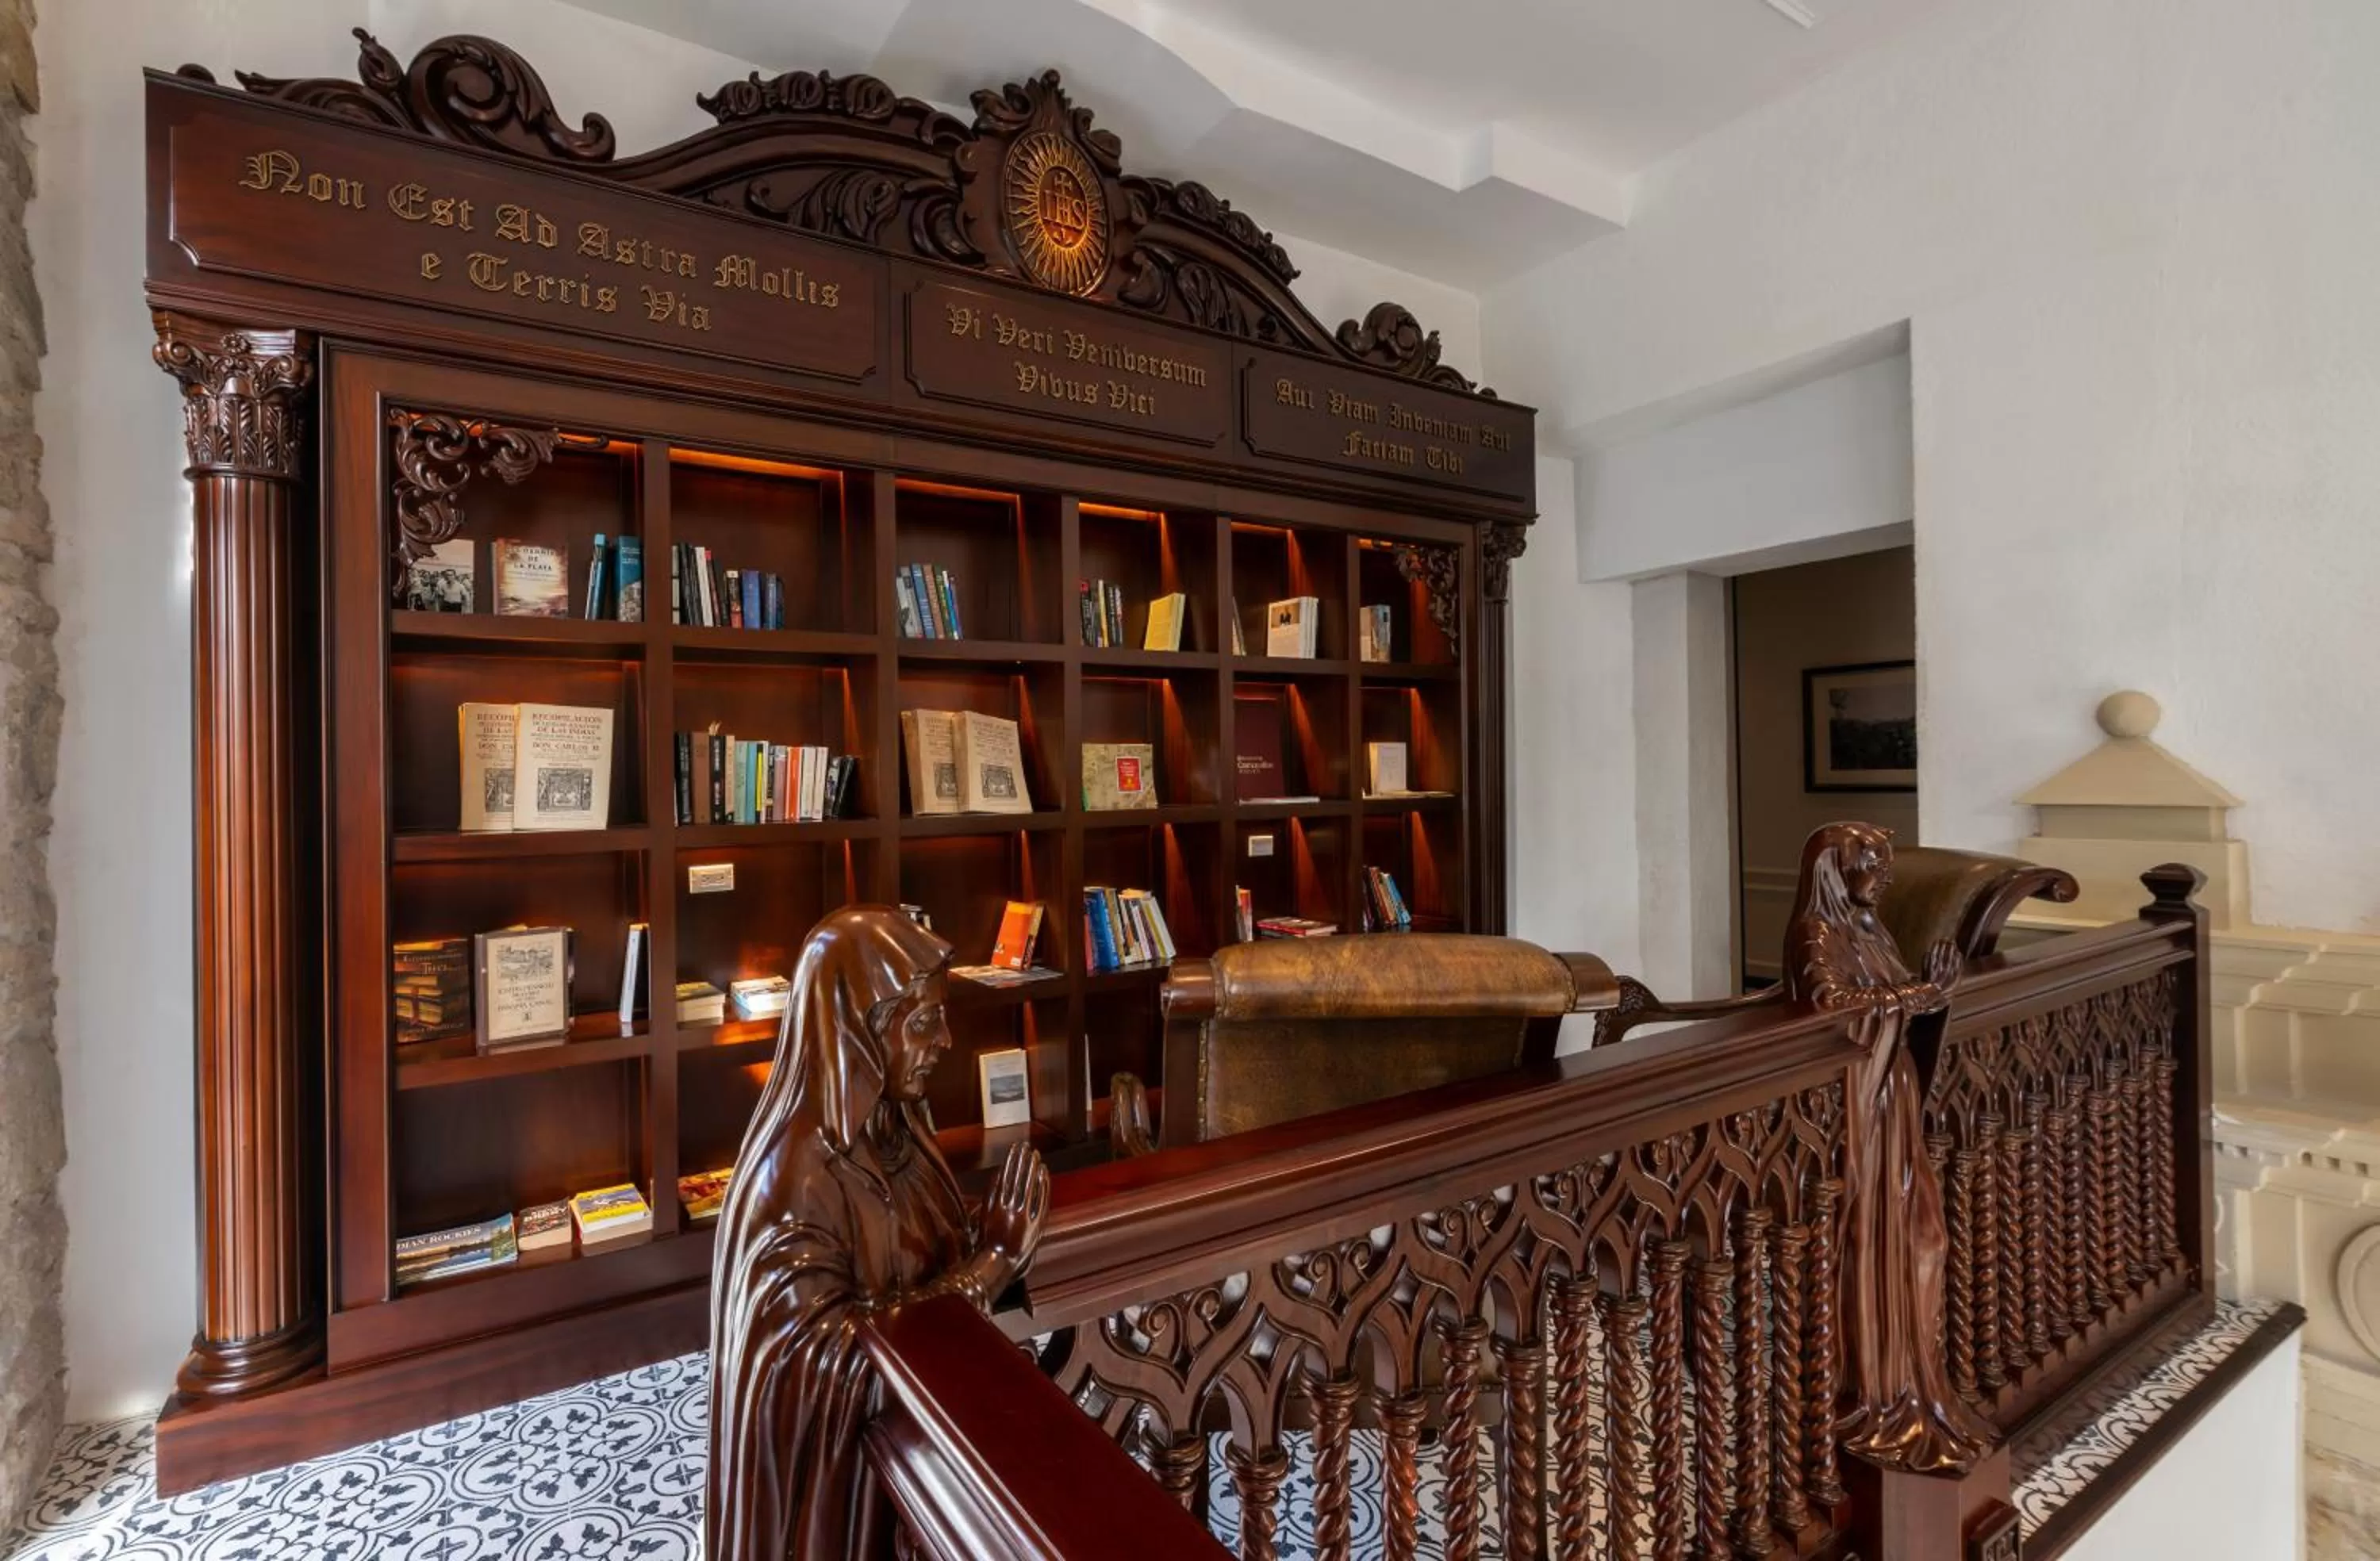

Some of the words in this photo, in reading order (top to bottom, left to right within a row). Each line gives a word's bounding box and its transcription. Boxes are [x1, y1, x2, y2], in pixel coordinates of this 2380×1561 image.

[239, 150, 367, 209] Non
[387, 182, 474, 231] Est
[495, 204, 558, 248] Ad
[577, 222, 697, 278] Astra
[714, 255, 841, 308] Mollis
[420, 252, 442, 279] e
[466, 251, 618, 313] Terris
[640, 285, 712, 331] Via
[946, 304, 981, 339] Vi
[993, 313, 1054, 355] Veri
[1327, 389, 1378, 424] Viam
